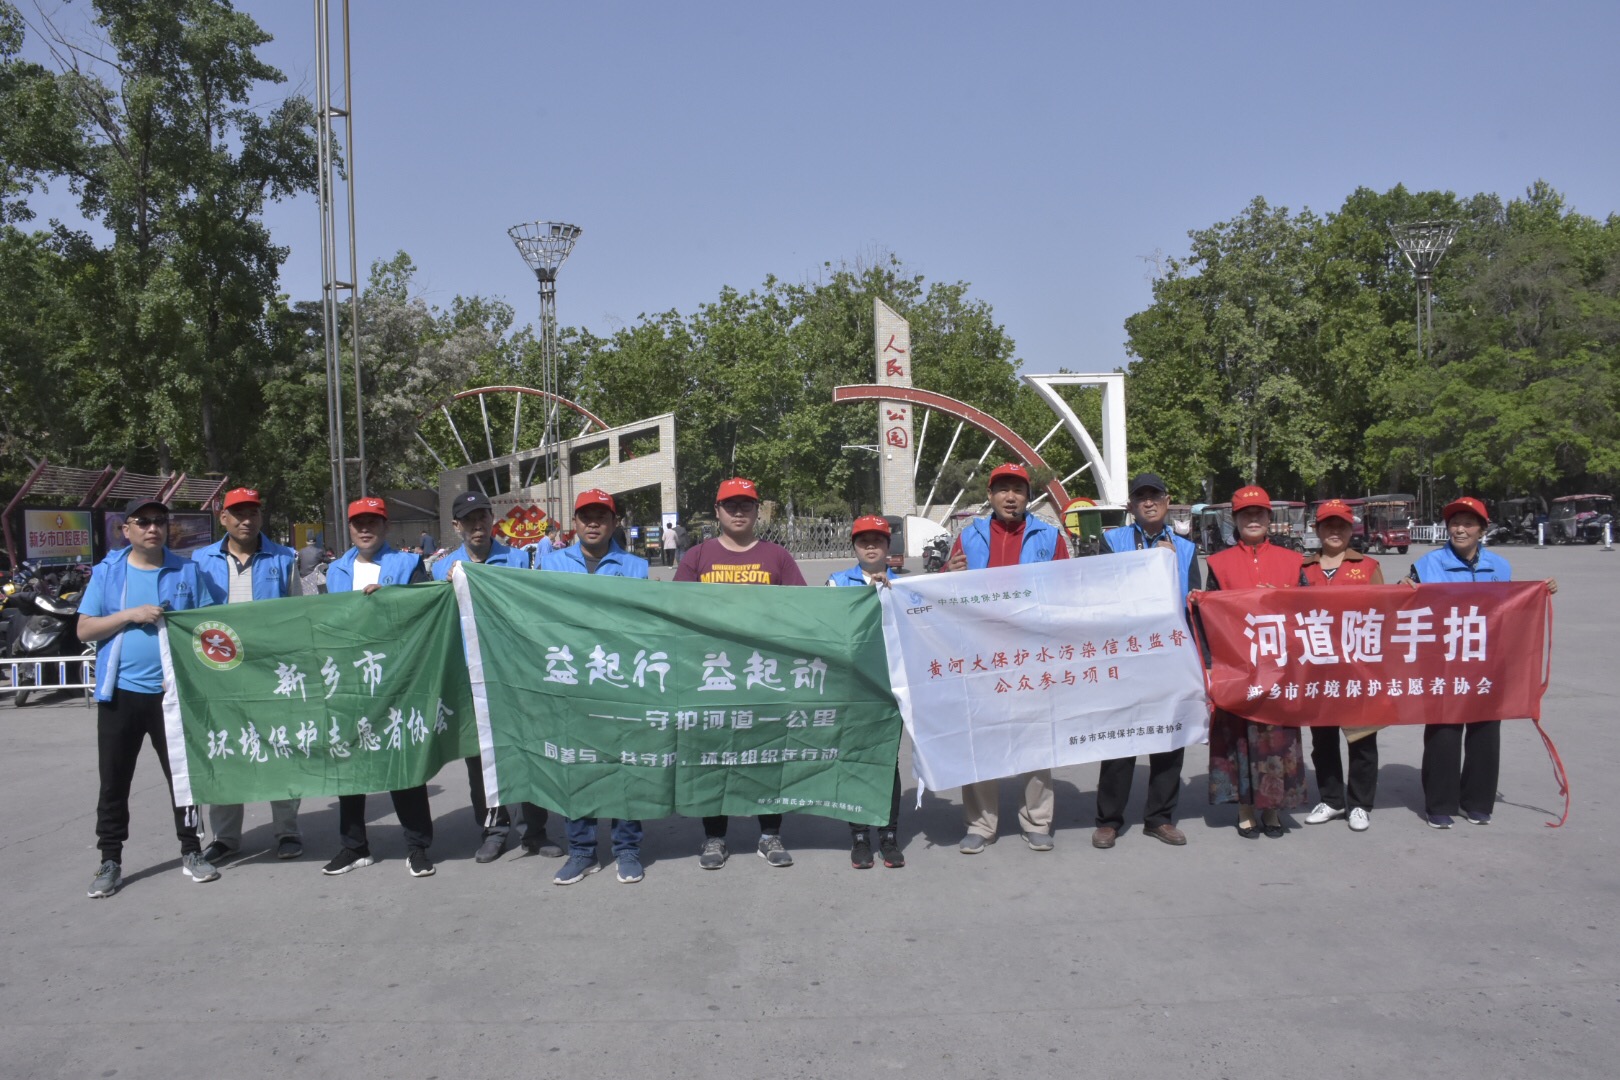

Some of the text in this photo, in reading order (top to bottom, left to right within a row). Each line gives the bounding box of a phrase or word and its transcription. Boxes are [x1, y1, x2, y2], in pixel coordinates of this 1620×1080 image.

[883, 334, 909, 449] 人民公园
[29, 530, 89, 548] 新乡市口腔医院
[701, 570, 770, 585] MINNESOTA
[906, 605, 933, 615] CEPF
[938, 589, 1032, 606] 中华环境保护基金会
[1243, 605, 1487, 668] 河道随手拍
[927, 629, 1188, 680] 黄河大保护水污染信息监督
[272, 650, 387, 702] 新乡市
[543, 644, 829, 695] 益起行 益起动
[993, 665, 1121, 694] 公众参与项目
[1247, 676, 1493, 701] 新乡市环境保护志愿者协会
[207, 698, 454, 763] 环境保护志愿者协会
[1069, 722, 1183, 746] 新乡市环境保护志愿者协会
